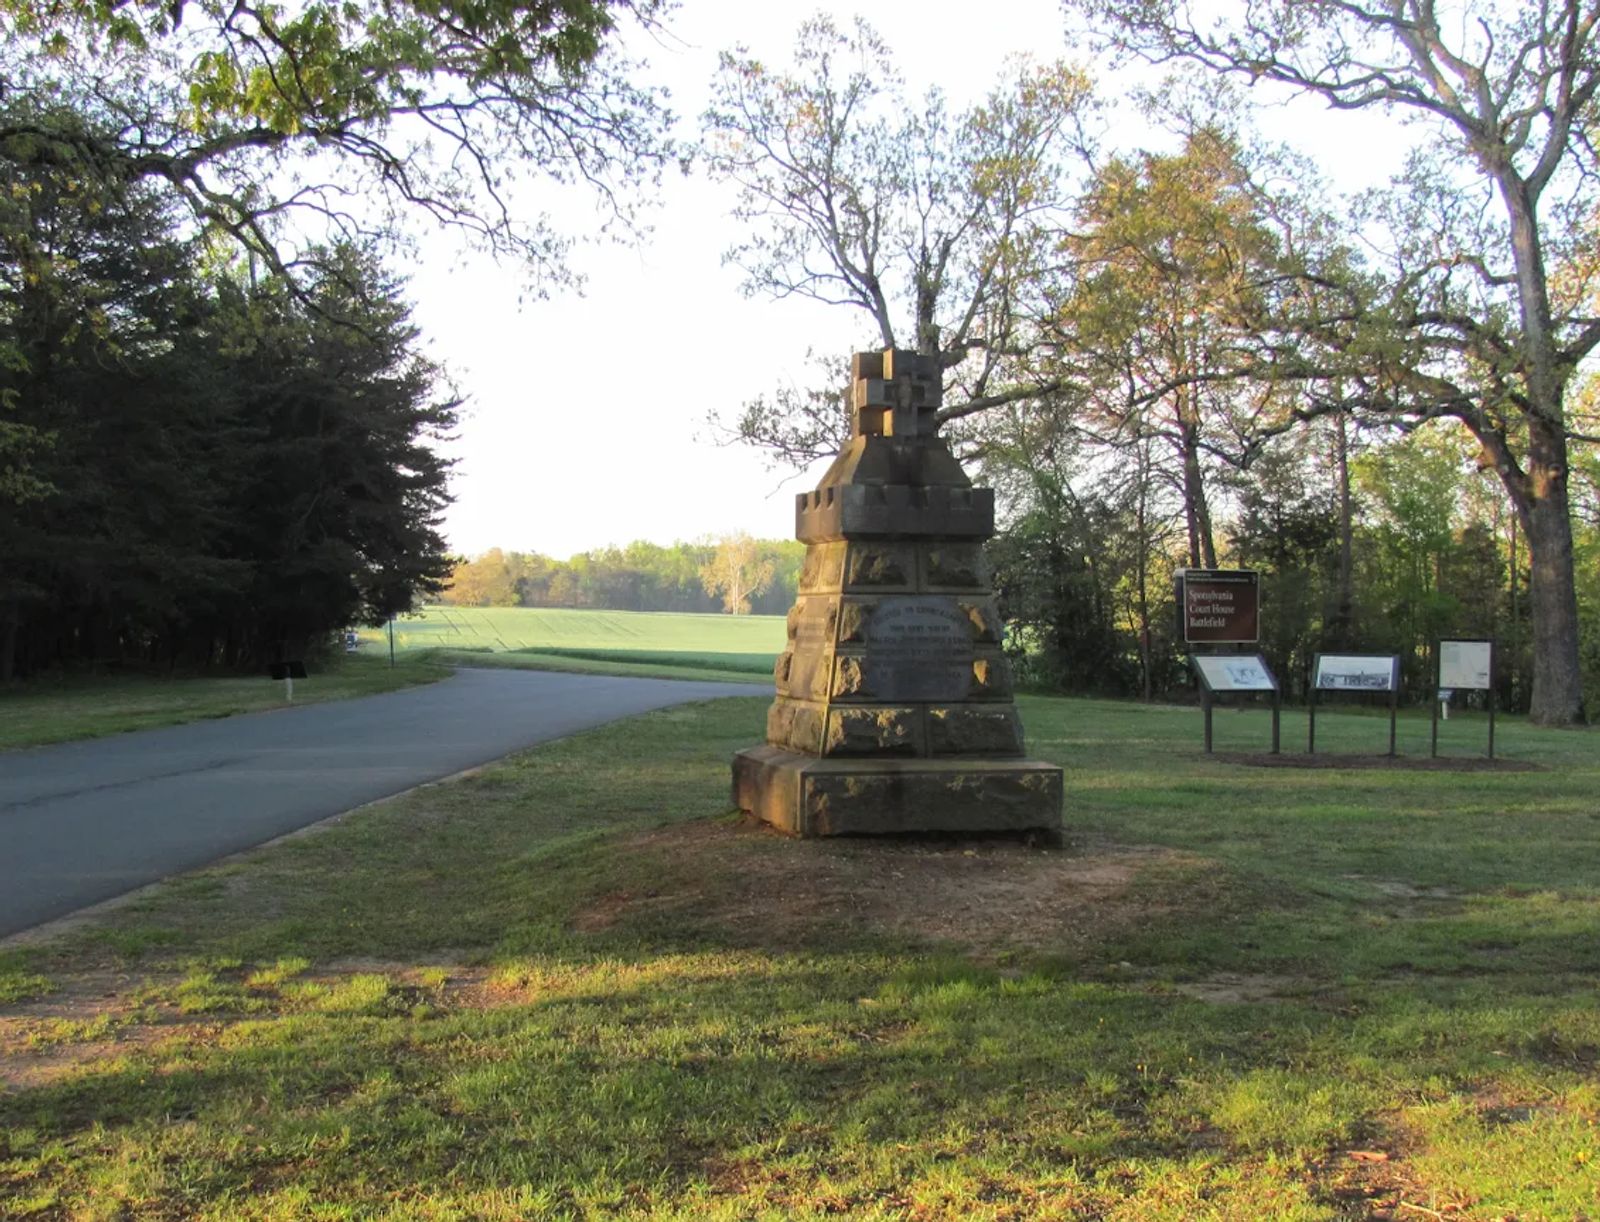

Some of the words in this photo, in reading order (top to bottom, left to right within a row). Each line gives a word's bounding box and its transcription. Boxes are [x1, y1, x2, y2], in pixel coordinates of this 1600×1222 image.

[1189, 604, 1211, 614] Court
[1212, 604, 1235, 614] House
[1190, 616, 1226, 628] Battlefield
